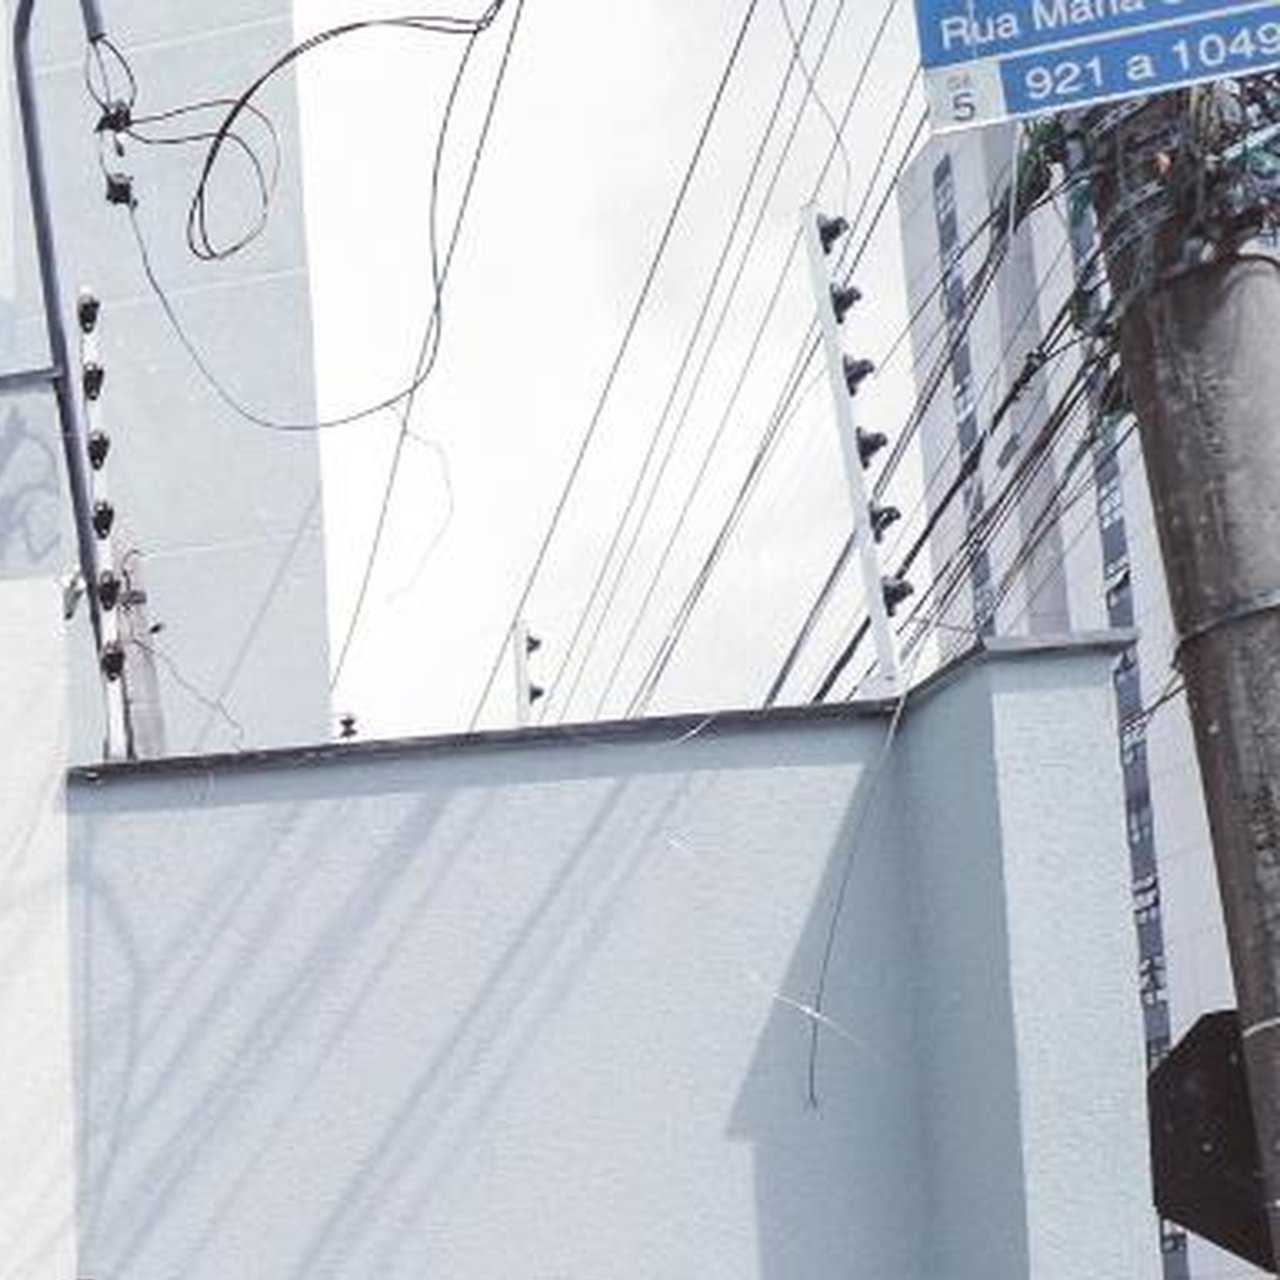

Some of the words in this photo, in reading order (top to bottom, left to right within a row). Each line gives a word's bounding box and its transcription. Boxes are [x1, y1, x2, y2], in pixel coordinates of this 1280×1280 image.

[941, 15, 1019, 49] Rua
[1025, 55, 1104, 98] 921
[1126, 53, 1156, 80] a
[1172, 22, 1280, 71] 1049
